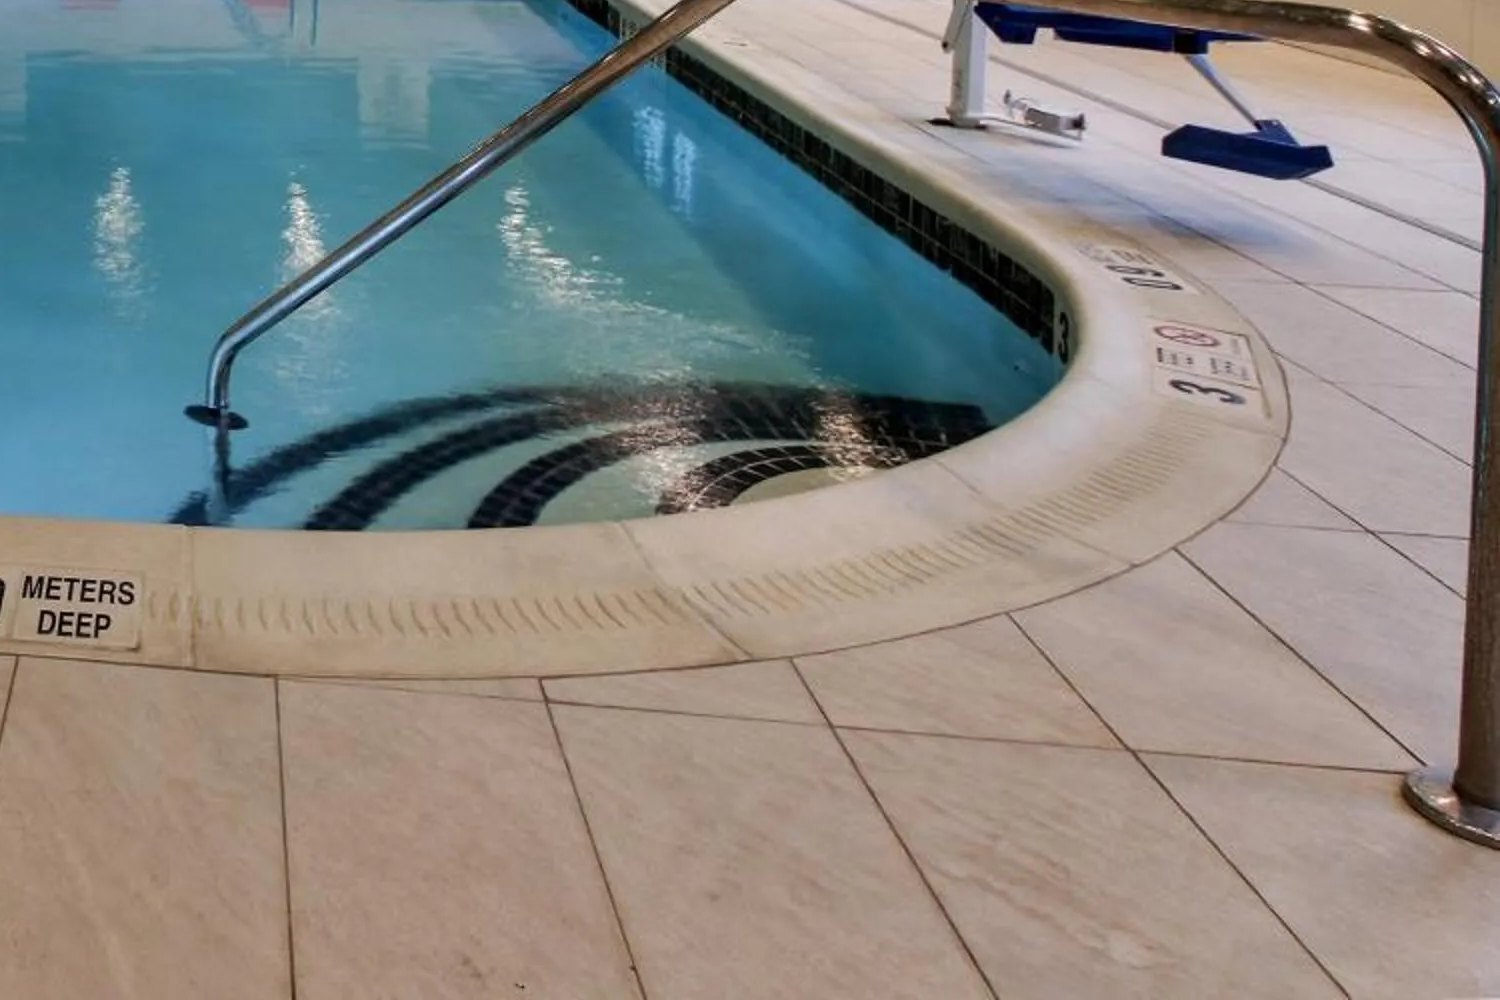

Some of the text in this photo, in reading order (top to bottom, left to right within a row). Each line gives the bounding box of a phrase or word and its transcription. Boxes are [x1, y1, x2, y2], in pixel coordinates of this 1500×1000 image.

[1169, 379, 1246, 405] 3
[22, 575, 135, 605] METERS
[37, 609, 111, 639] DEEP
